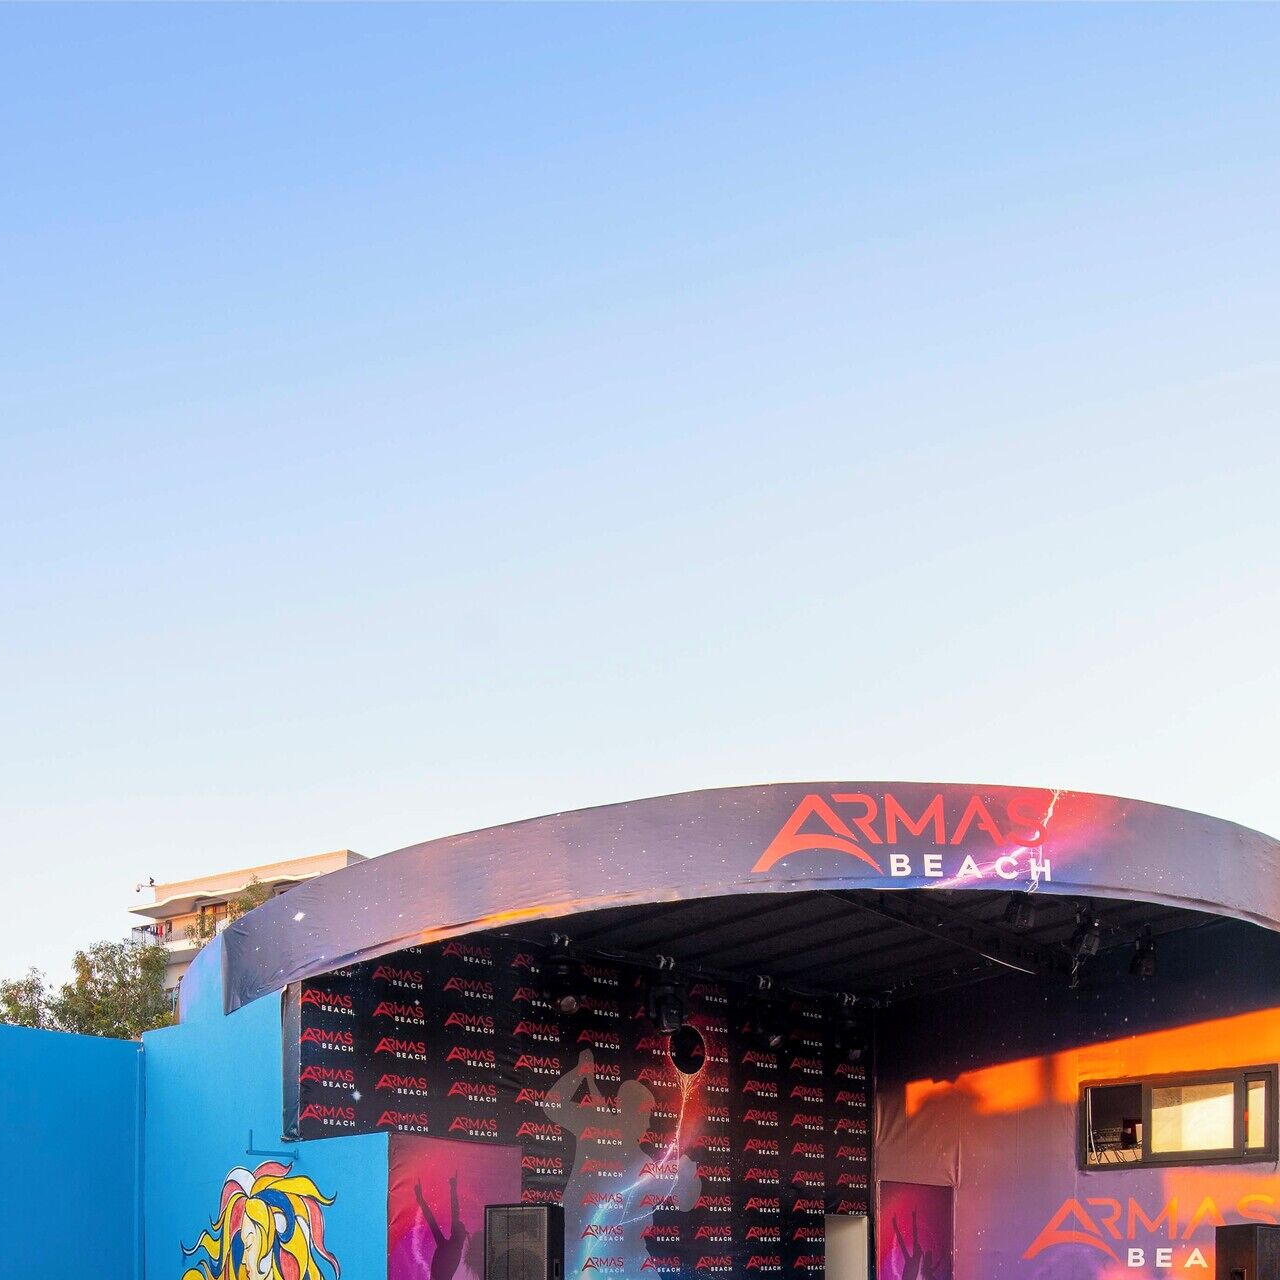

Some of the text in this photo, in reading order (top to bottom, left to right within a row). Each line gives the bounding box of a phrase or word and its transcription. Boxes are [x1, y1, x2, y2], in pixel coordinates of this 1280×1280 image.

[751, 792, 1049, 876] ARMAS
[889, 853, 1052, 882] BEACH
[464, 956, 493, 965] BEACH
[372, 965, 422, 983] ARMAS
[393, 980, 422, 990] BEACH
[443, 977, 493, 993] ARMAS
[593, 977, 618, 985] BEACH
[300, 988, 352, 1008] ARMAS
[465, 991, 493, 1000] BEACH
[706, 996, 727, 1004] BEACH
[321, 1005, 353, 1015] BEACH
[372, 1001, 424, 1019] ARMAS
[594, 1010, 619, 1018] BEACH
[395, 1016, 425, 1025] BEACH
[444, 1012, 494, 1028] ARMAS
[466, 1026, 494, 1034] BEACH
[513, 1021, 559, 1035] ARMAS
[299, 1027, 353, 1045] ARMAS
[533, 1034, 559, 1042] BEACH
[577, 1030, 619, 1043] ARMAS
[322, 1043, 354, 1052] BEACH
[374, 1037, 425, 1055] ARMAS
[396, 1052, 426, 1061] BEACH
[445, 1047, 495, 1063] ARMAS
[653, 1049, 676, 1057] BEACH
[742, 1051, 776, 1064] ARMAS
[467, 1061, 495, 1069] BEACH
[515, 1055, 559, 1069] ARMAS
[299, 1066, 354, 1084] ARMAS
[577, 1062, 620, 1076] ARMAS
[323, 1081, 355, 1089] BEACH
[375, 1074, 427, 1092] ARMAS
[743, 1080, 777, 1093] ARMAS
[398, 1088, 428, 1096] BEACH
[447, 1082, 496, 1098] ARMAS
[515, 1088, 560, 1103] ARMAS
[790, 1086, 823, 1098] ARMAS
[300, 1104, 355, 1121] ARMAS
[376, 1110, 428, 1127] ARMAS
[743, 1109, 777, 1122] ARMAS
[448, 1116, 497, 1132] ARMAS
[791, 1114, 823, 1127] ARMAS
[835, 1118, 866, 1130] ARMAS
[516, 1122, 561, 1137] ARMAS
[745, 1138, 779, 1152] ARMAS
[791, 1142, 824, 1155] ARMAS
[836, 1146, 866, 1158] ARMAS
[521, 1156, 562, 1169] ARMAS
[639, 1163, 678, 1177] ARMAS
[694, 1165, 731, 1179] ARMAS
[744, 1168, 779, 1181] ARMAS
[792, 1171, 824, 1184] ARMAS
[837, 1173, 866, 1185] ARMAS
[521, 1190, 563, 1202] ARMAS
[580, 1192, 623, 1206] ARMAS
[640, 1194, 678, 1207] ARMAS
[694, 1195, 731, 1209] ARMAS
[745, 1196, 780, 1210] ARMAS
[792, 1199, 824, 1212] ARMAS
[837, 1200, 867, 1213] ARMAS
[581, 1224, 624, 1238] ARMAS
[640, 1226, 679, 1239] ARMAS
[695, 1225, 732, 1239] ARMAS
[745, 1226, 780, 1240] ARMAS
[793, 1227, 824, 1240] ARMAS
[1023, 1193, 1279, 1263] ARMAS
[582, 1257, 623, 1272] ARMAS
[640, 1257, 680, 1271] ARMAS
[695, 1256, 732, 1269] ARMAS
[746, 1256, 781, 1269] ARMAS
[793, 1256, 825, 1269] ARMAS
[1127, 1248, 1208, 1268] BEA
